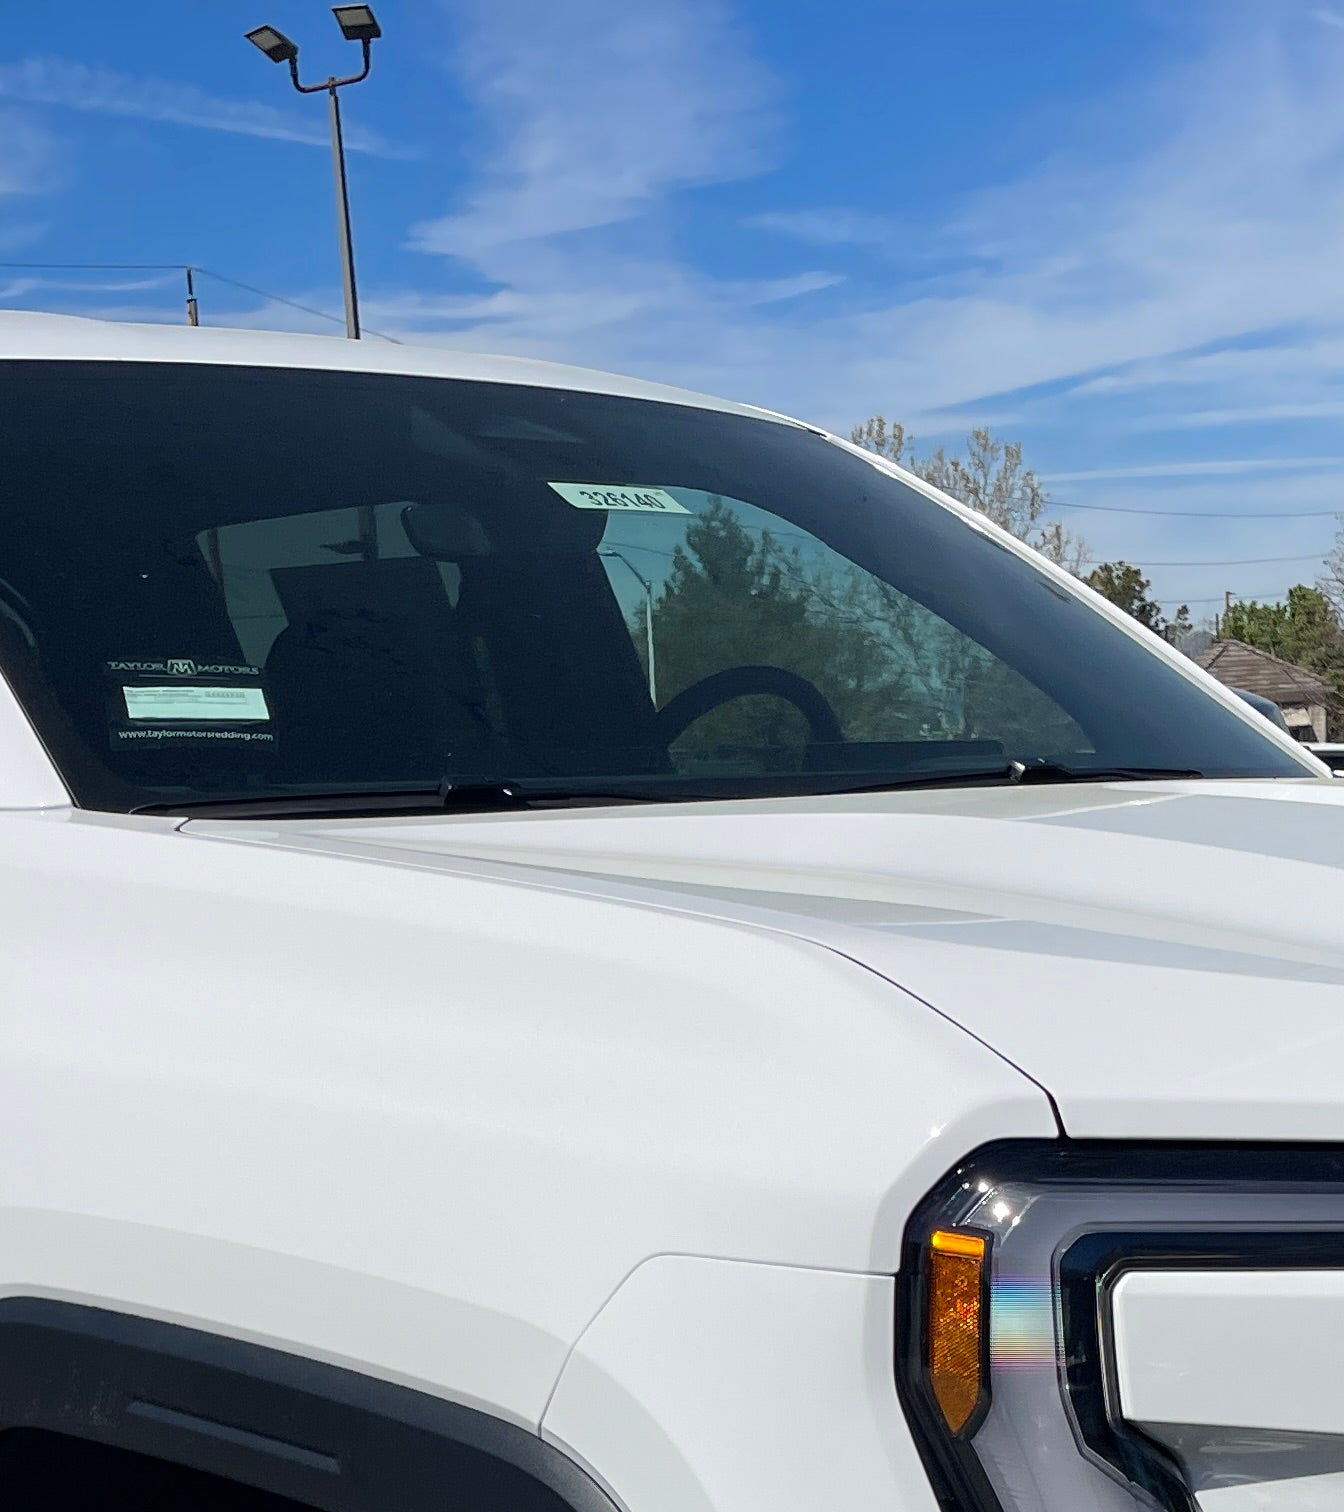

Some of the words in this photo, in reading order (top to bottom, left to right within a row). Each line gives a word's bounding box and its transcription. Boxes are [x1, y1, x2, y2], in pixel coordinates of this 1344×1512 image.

[579, 490, 666, 509] 326140
[107, 661, 167, 672] TAYLOR
[197, 664, 260, 675] MOTORS
[118, 729, 274, 741] www.taylormotorsredding.com
